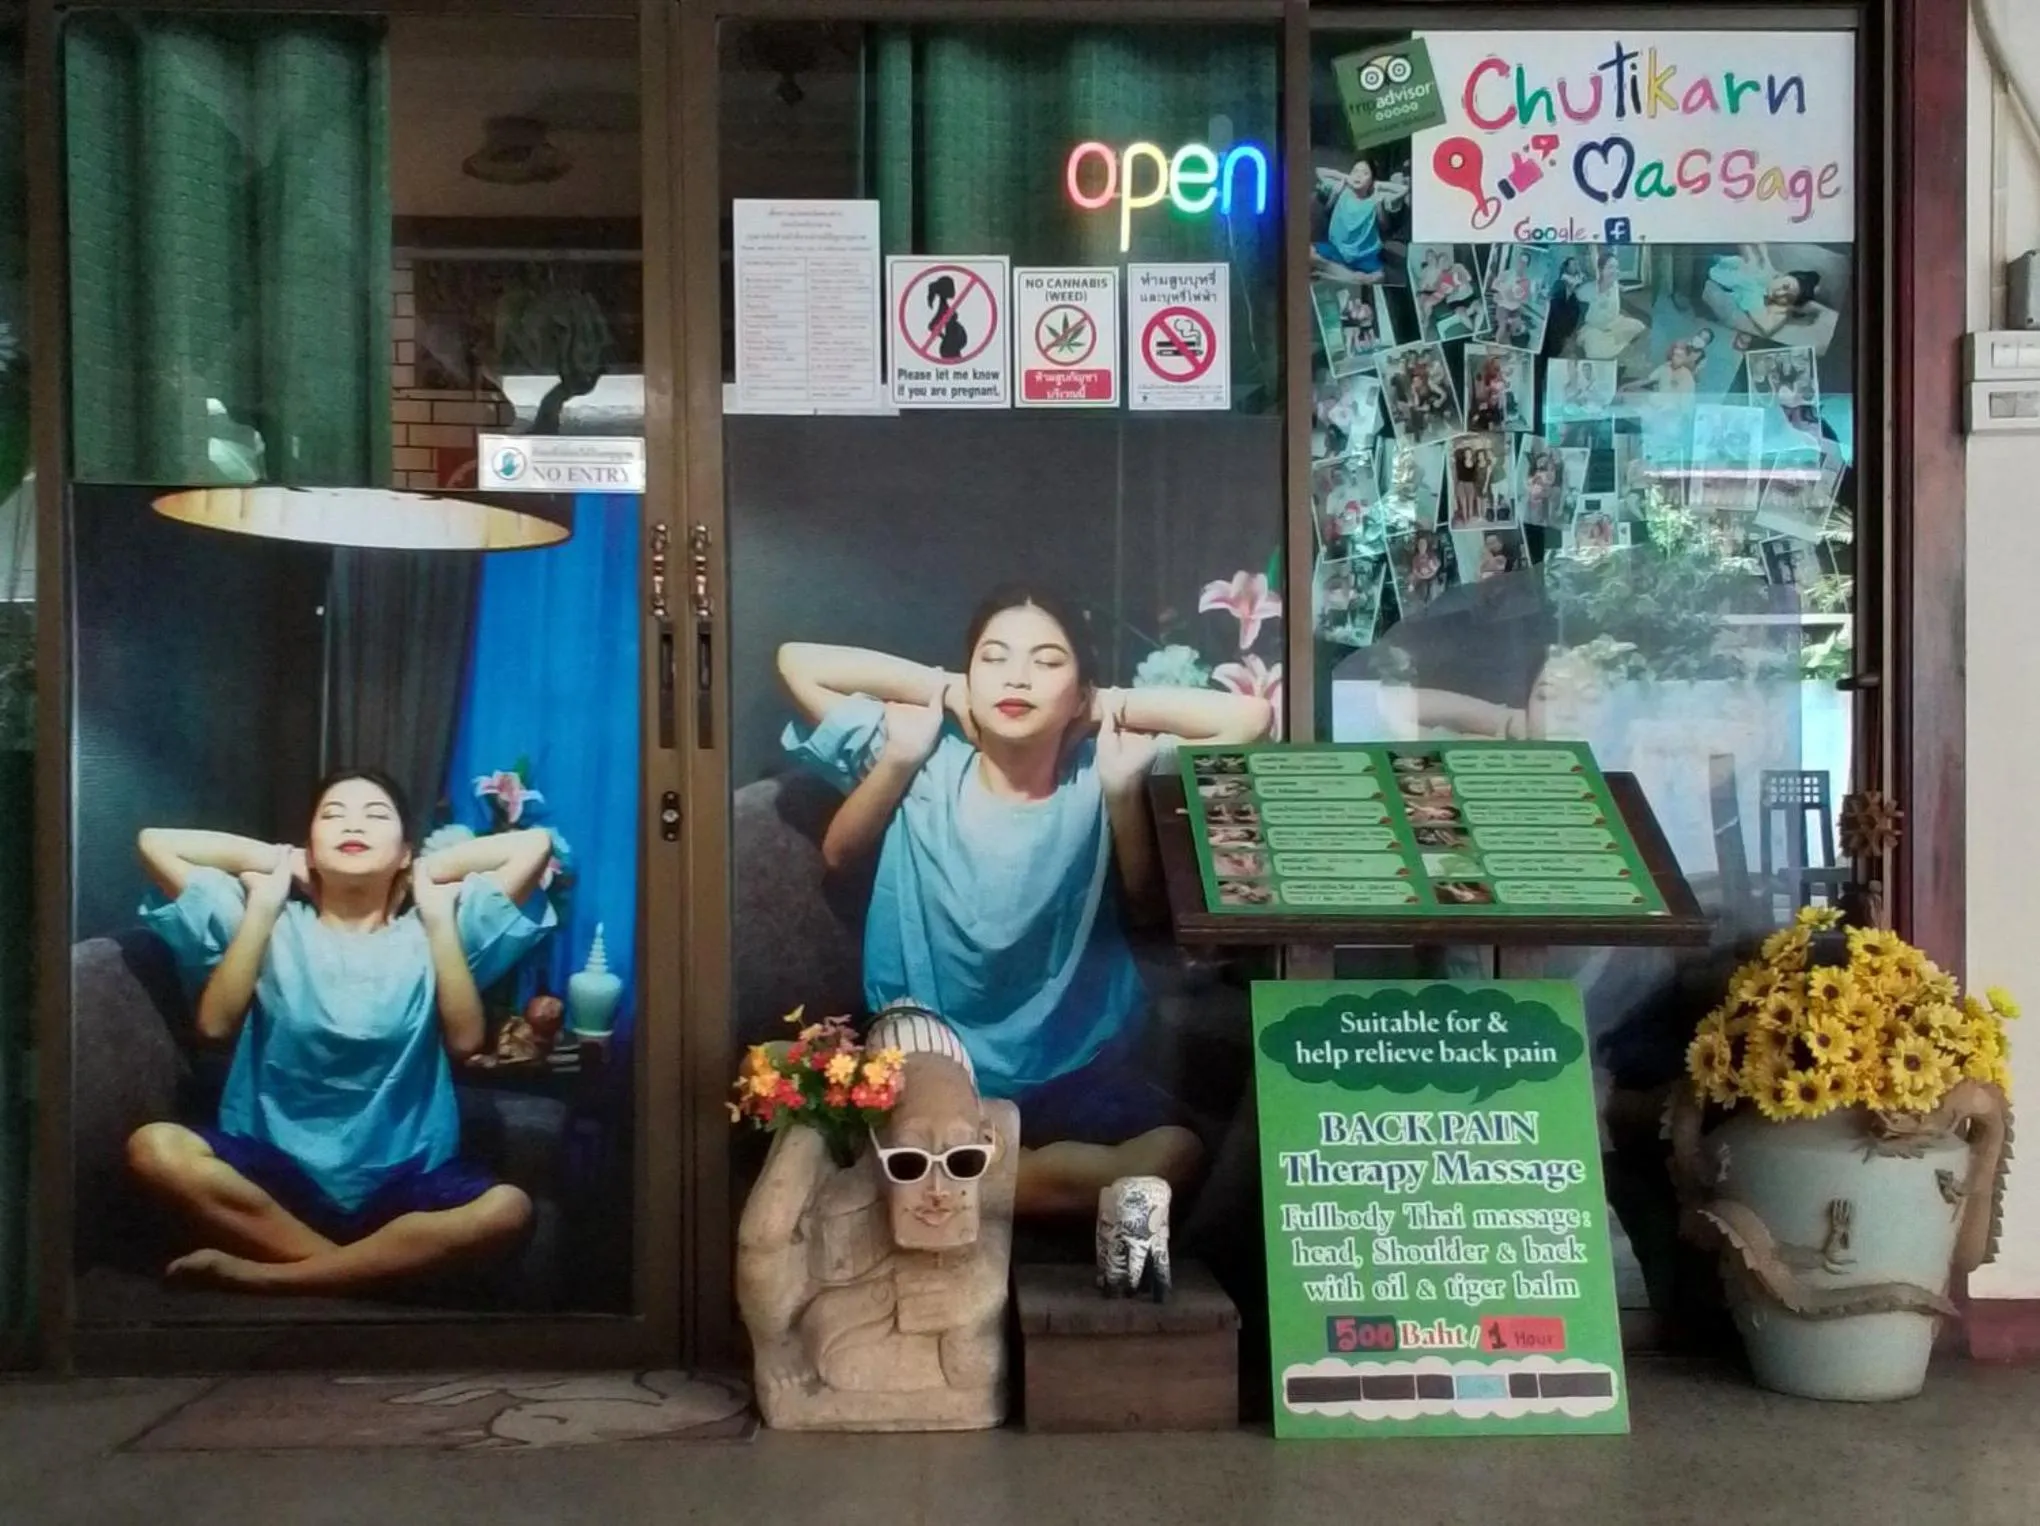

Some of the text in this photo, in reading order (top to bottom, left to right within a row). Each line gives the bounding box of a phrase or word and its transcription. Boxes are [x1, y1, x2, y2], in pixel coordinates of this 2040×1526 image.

[1462, 40, 1806, 131] Chutikarn
[1573, 135, 1842, 223] Massage
[1067, 142, 1268, 252] open
[1514, 216, 1586, 241] Google
[1025, 278, 1109, 289] NO CANNABIS
[1045, 290, 1088, 303] (WEED)
[897, 368, 1000, 381] Please let me know
[908, 387, 928, 399] you
[931, 387, 947, 397] are
[533, 467, 630, 482] NO ENTRY
[1340, 1011, 1508, 1034] Suitable for &
[1295, 1039, 1558, 1069] help relieve back pain
[1319, 1111, 1539, 1146] BACK PAIN
[1280, 1151, 1586, 1193] Therapy Massage
[1281, 1203, 1395, 1233] Fullbody
[1403, 1203, 1466, 1230] Thai
[1292, 1238, 1588, 1268] head, Shoulder & back
[1304, 1272, 1581, 1305] with oil & tiger balm
[1334, 1318, 1396, 1350] 500
[1487, 1320, 1508, 1350] 1
[1513, 1332, 1554, 1348] Hour
